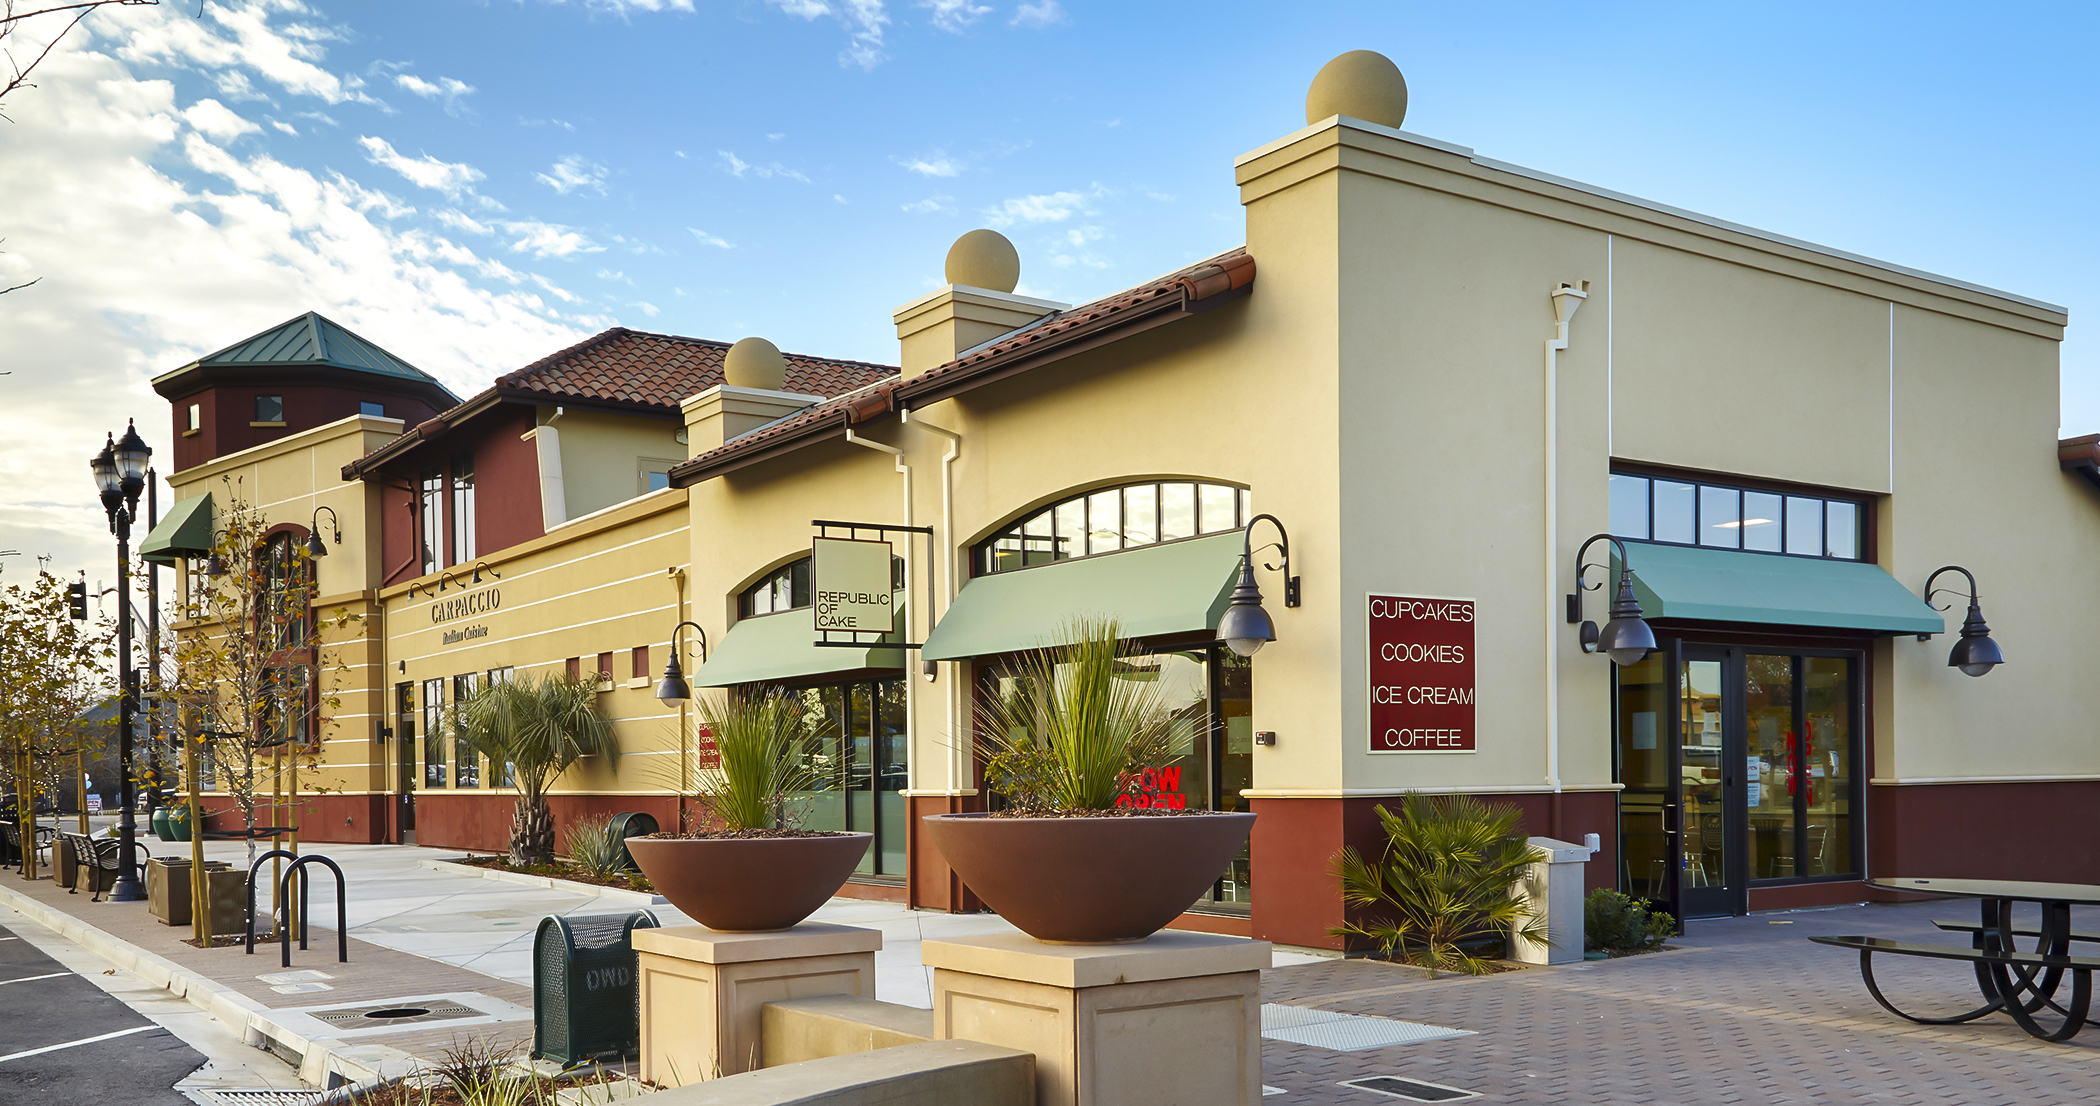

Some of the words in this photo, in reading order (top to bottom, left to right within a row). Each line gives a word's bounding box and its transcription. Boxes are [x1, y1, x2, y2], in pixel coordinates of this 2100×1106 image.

[432, 588, 500, 623] CARPACCIO
[818, 591, 890, 605] REPUBLIC
[818, 603, 838, 614] OF
[1371, 599, 1474, 622] CUPCAKES
[818, 615, 857, 627] CAKE
[1375, 622, 1471, 642] REPUBLIC
[1381, 643, 1465, 664] COOKIES
[1372, 686, 1403, 704] ICE
[1407, 686, 1474, 705] CREAM
[1398, 707, 1449, 726] CAKE
[1385, 728, 1462, 747] COFFEE
[1786, 731, 1797, 795] NOW
[1121, 767, 1181, 792] OW
